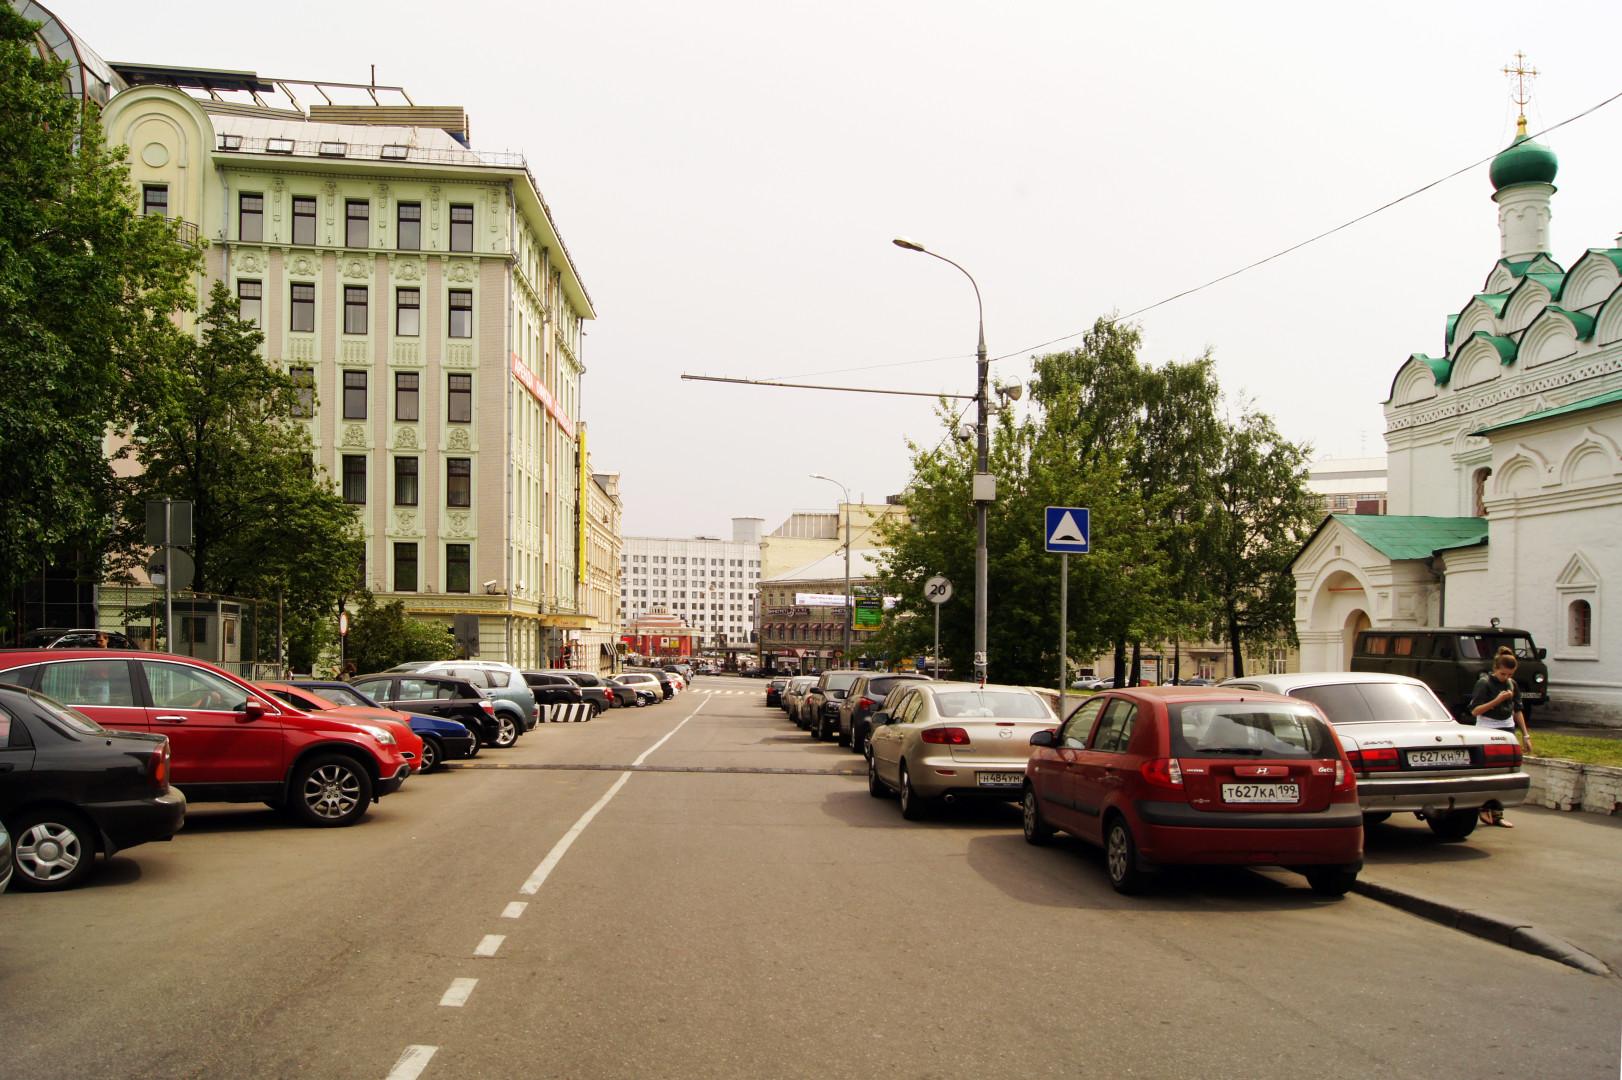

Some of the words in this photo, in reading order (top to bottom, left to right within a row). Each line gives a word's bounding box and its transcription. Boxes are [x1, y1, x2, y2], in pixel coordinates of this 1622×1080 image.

[930, 584, 946, 595] 20
[1456, 750, 1466, 759] 97
[1228, 785, 1276, 798] Т627КА
[1278, 785, 1296, 795] 199
